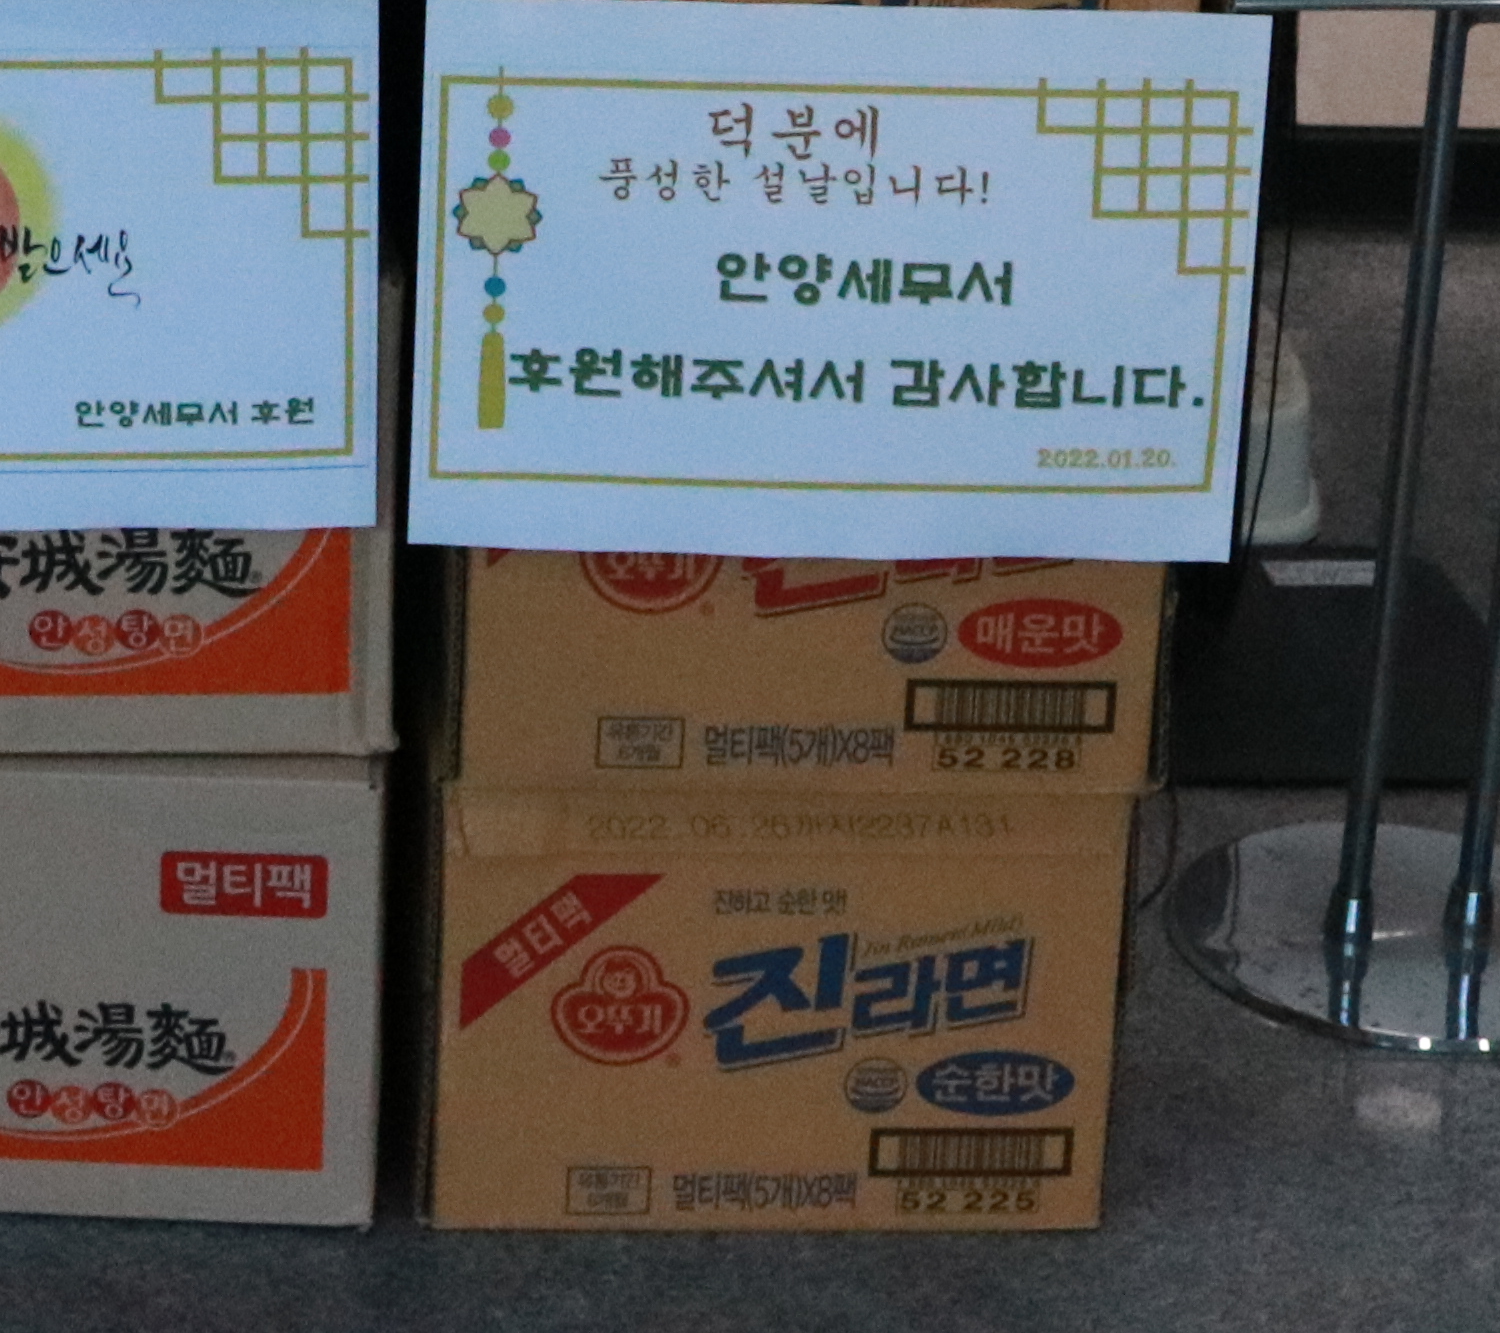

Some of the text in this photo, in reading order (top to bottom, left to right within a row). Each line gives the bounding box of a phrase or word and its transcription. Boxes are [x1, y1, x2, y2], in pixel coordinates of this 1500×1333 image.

[598, 156, 993, 207] 풍성한 설날입니다!
[716, 252, 1016, 309] 안양세무서
[507, 346, 1206, 411] 후원해주셔서 감사합니다.
[74, 396, 317, 428] 안양세무서 후원
[1036, 447, 1178, 473] 2022.01.20.
[29, 609, 203, 658] 안성탕면
[974, 610, 1104, 655] 매운맛
[935, 746, 1078, 772] 52 228
[174, 858, 314, 910] 멀티팩
[713, 888, 772, 915] 진하고
[777, 887, 818, 916] 순한
[491, 891, 594, 978] 멀티팩
[575, 1002, 667, 1034] 오뚜기
[702, 931, 1036, 1073] 진라면
[7, 1080, 181, 1127] 안성탕면
[930, 1062, 1059, 1103] 순한맛
[900, 1190, 1038, 1212] 52 225
